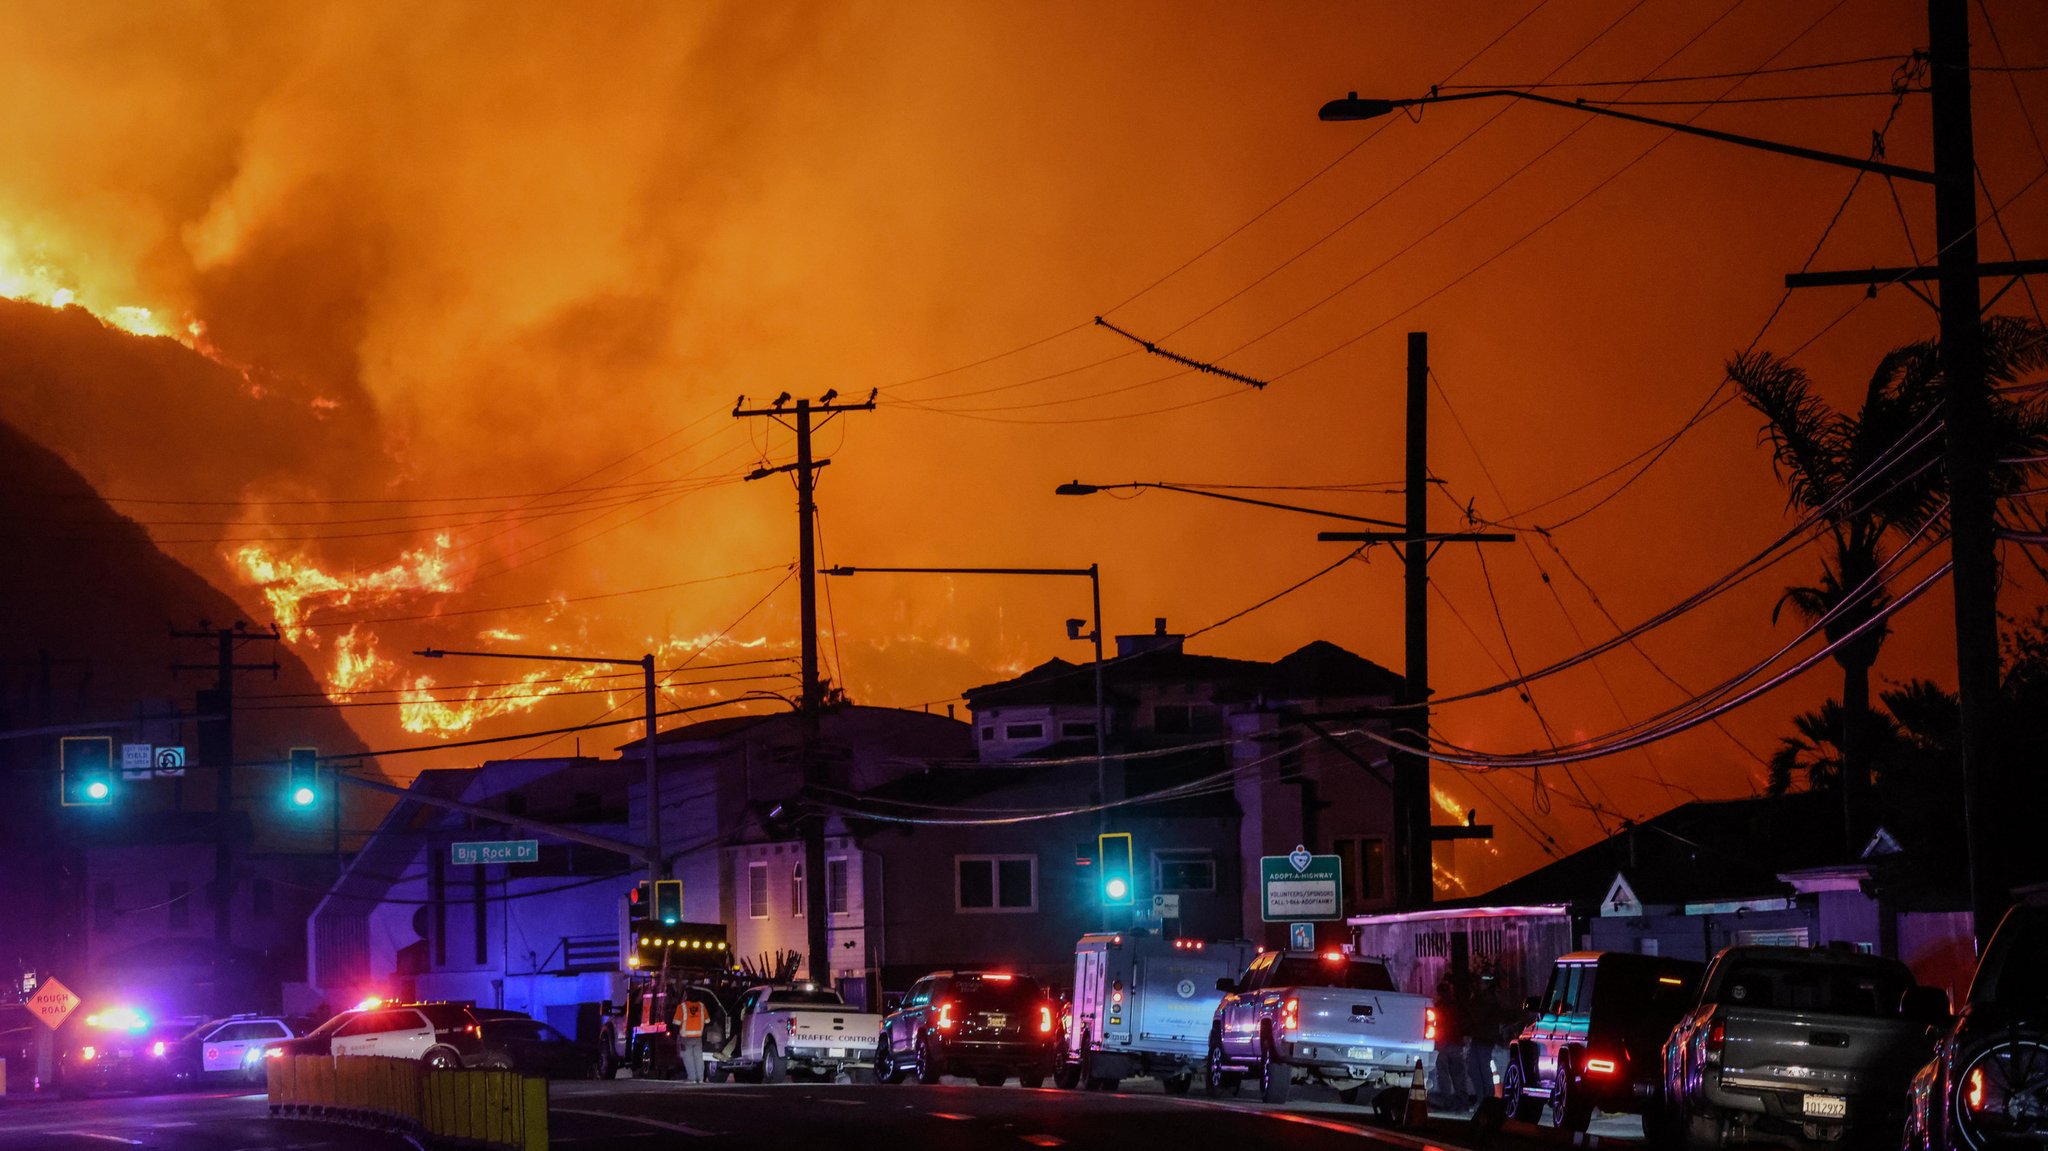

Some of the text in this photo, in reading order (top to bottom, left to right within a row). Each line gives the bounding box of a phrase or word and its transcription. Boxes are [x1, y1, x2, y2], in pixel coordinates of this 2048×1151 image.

[458, 846, 532, 862] Big Rock Dr
[37, 994, 69, 1004] ROUGH
[41, 1005, 66, 1014] ROAD
[1806, 1102, 1844, 1115] 10129X2
